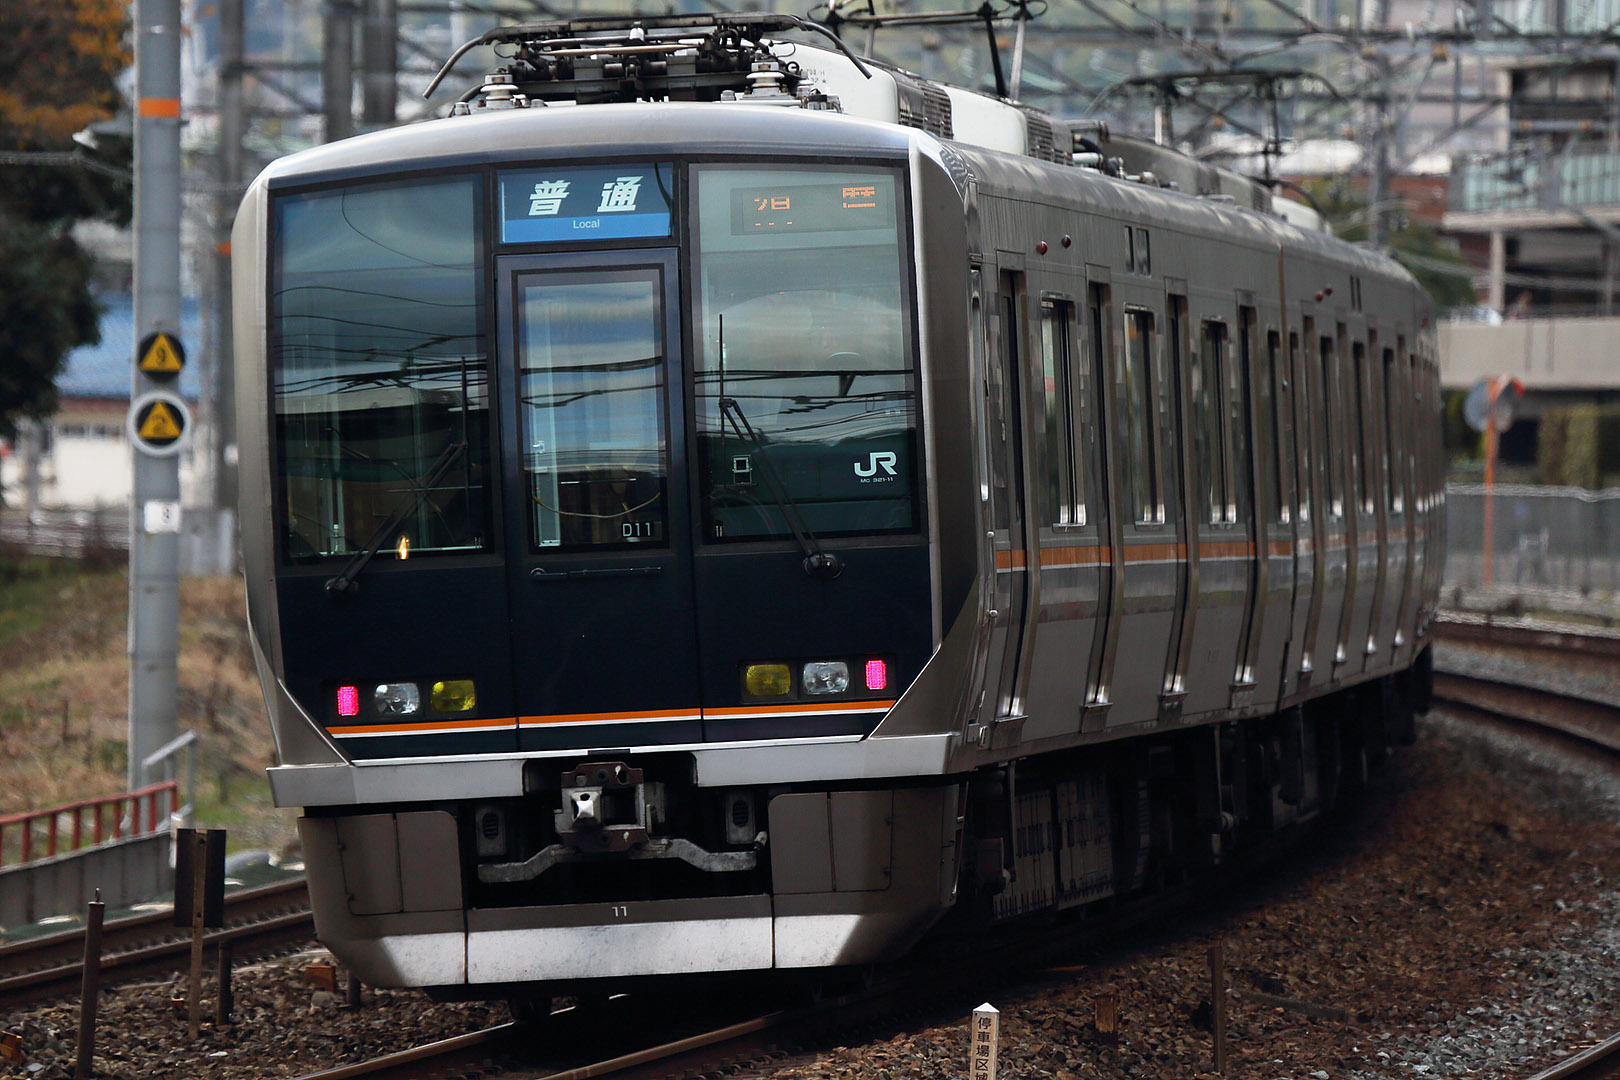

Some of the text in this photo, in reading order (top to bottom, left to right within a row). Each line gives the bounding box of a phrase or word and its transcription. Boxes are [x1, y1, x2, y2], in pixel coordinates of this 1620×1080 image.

[528, 175, 643, 216] 普通
[572, 219, 600, 229] Local
[854, 451, 898, 477] JR
[622, 522, 651, 537] D11
[611, 905, 628, 917] 11
